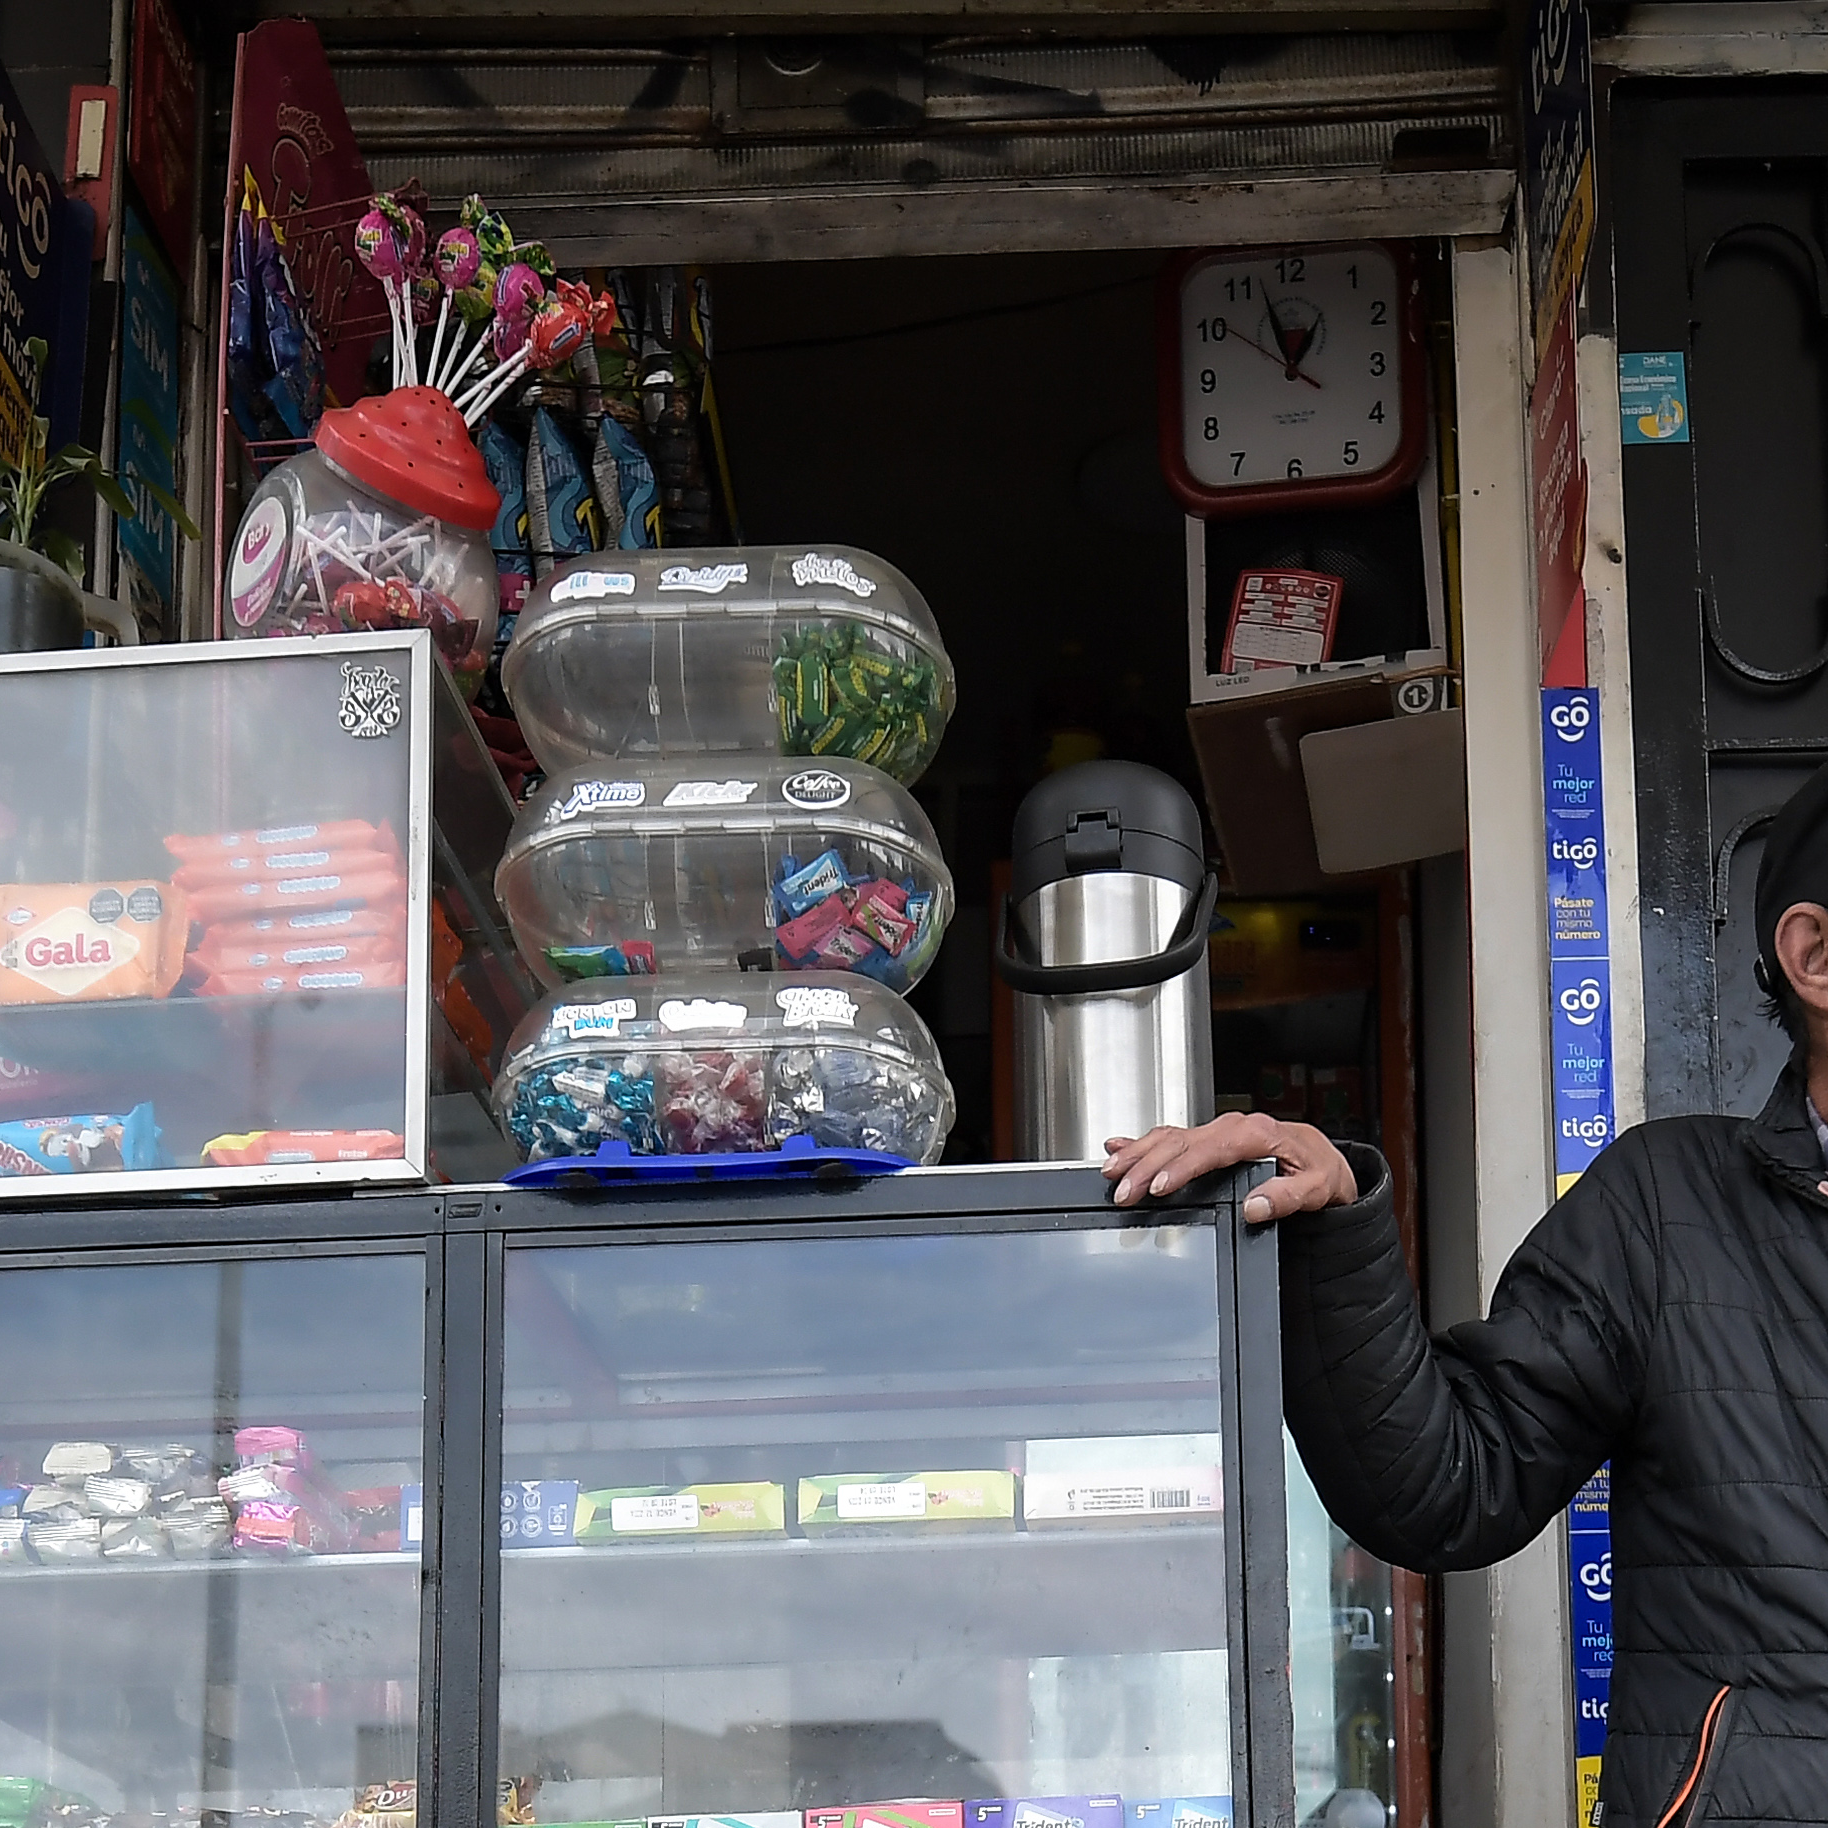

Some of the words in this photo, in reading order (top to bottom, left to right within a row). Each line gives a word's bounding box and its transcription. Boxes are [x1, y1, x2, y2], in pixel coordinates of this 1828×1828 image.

[1274, 258, 1306, 284] 12
[1347, 264, 1357, 289] 1
[1224, 276, 1251, 301] 11
[1370, 301, 1387, 325] 2
[1196, 317, 1227, 342] 10
[130, 297, 169, 392] SIM
[1369, 352, 1386, 377] 3
[1643, 355, 1666, 365] DANE
[1200, 369, 1217, 394] 9
[1368, 401, 1385, 424] 4
[1203, 416, 1219, 441] 8
[1343, 441, 1359, 465] 5
[1230, 452, 1246, 477] 7
[1557, 763, 1574, 778] Tu
[794, 790, 837, 799] DELIGHT
[1552, 777, 1595, 794] mejor
[1564, 790, 1587, 804] red
[1553, 838, 1598, 860] tigo
[1556, 907, 1578, 919] con
[1580, 907, 1591, 919] tu
[1555, 927, 1601, 941] número
[25, 933, 113, 968] Gala
[1566, 1042, 1583, 1057] Tu
[1562, 1055, 1606, 1073] mejor
[1574, 1069, 1597, 1083] red
[1562, 1115, 1608, 1141] tigo
[1587, 1619, 1603, 1633] Tu
[977, 1807, 987, 1821] 5
[1136, 1805, 1146, 1819] 5
